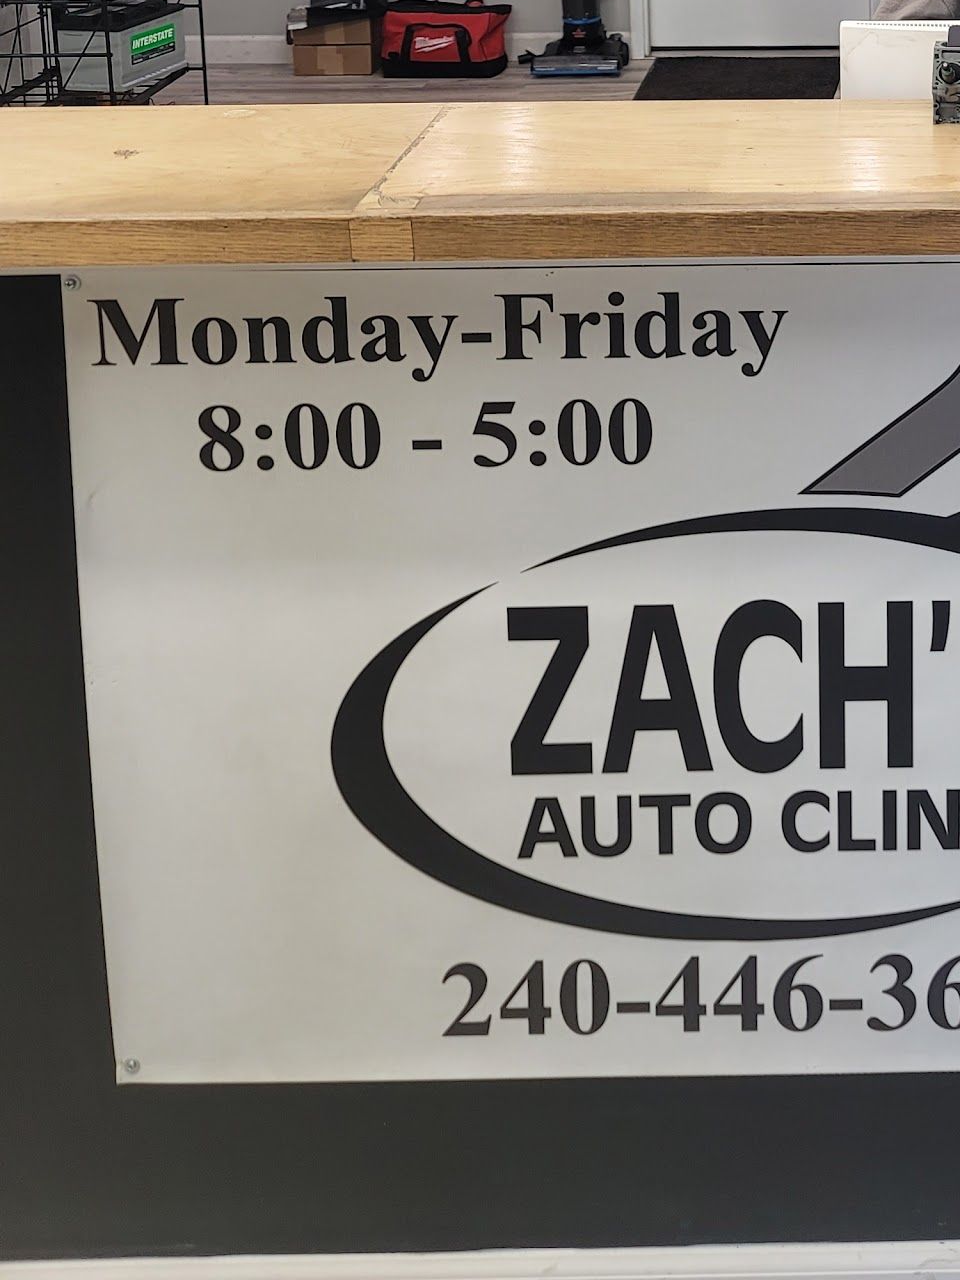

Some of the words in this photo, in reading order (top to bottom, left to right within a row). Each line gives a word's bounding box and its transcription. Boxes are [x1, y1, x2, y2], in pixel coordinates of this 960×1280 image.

[132, 28, 174, 50] INTERSTATE
[87, 290, 789, 382] Monday-Friday
[197, 403, 382, 472] 8:00
[472, 398, 653, 467] 5:00
[517, 791, 753, 859] AUTO
